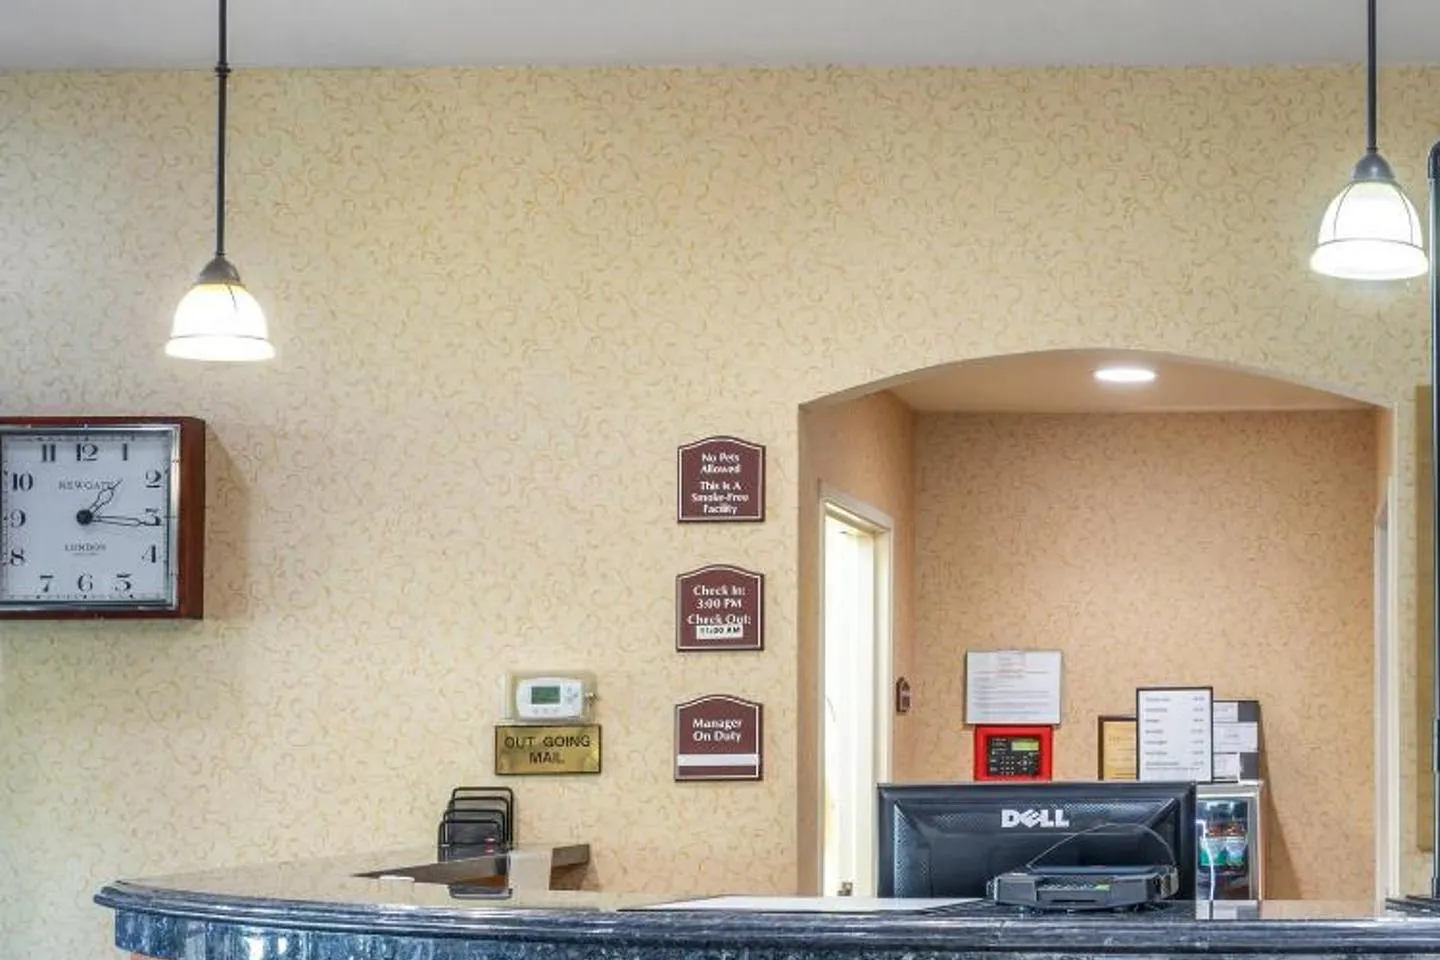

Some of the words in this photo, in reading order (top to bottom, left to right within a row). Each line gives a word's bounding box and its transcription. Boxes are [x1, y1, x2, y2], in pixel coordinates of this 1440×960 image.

[41, 443, 57, 462] 11
[76, 443, 99, 462] 12
[121, 443, 129, 462] 1
[701, 452, 717, 462] No
[719, 452, 740, 463] Pets
[700, 463, 741, 474] Allowed
[11, 471, 34, 491] 10
[145, 469, 162, 488] 2
[699, 481, 720, 490] This
[733, 481, 741, 490] A
[10, 509, 26, 528] 9
[10, 547, 25, 567] 8
[142, 544, 157, 563] 4
[39, 574, 55, 593] 7
[77, 572, 94, 593] 6
[115, 573, 133, 593] 5
[692, 584, 729, 596] Check
[696, 598, 721, 609] 3:00
[724, 598, 742, 609] PM
[686, 613, 723, 625] Check
[692, 718, 742, 730] Manager
[503, 736, 537, 749] OUT
[542, 734, 591, 748] GOING
[692, 731, 712, 742] On
[714, 731, 742, 743] Duty
[1001, 808, 1070, 829] DELL
